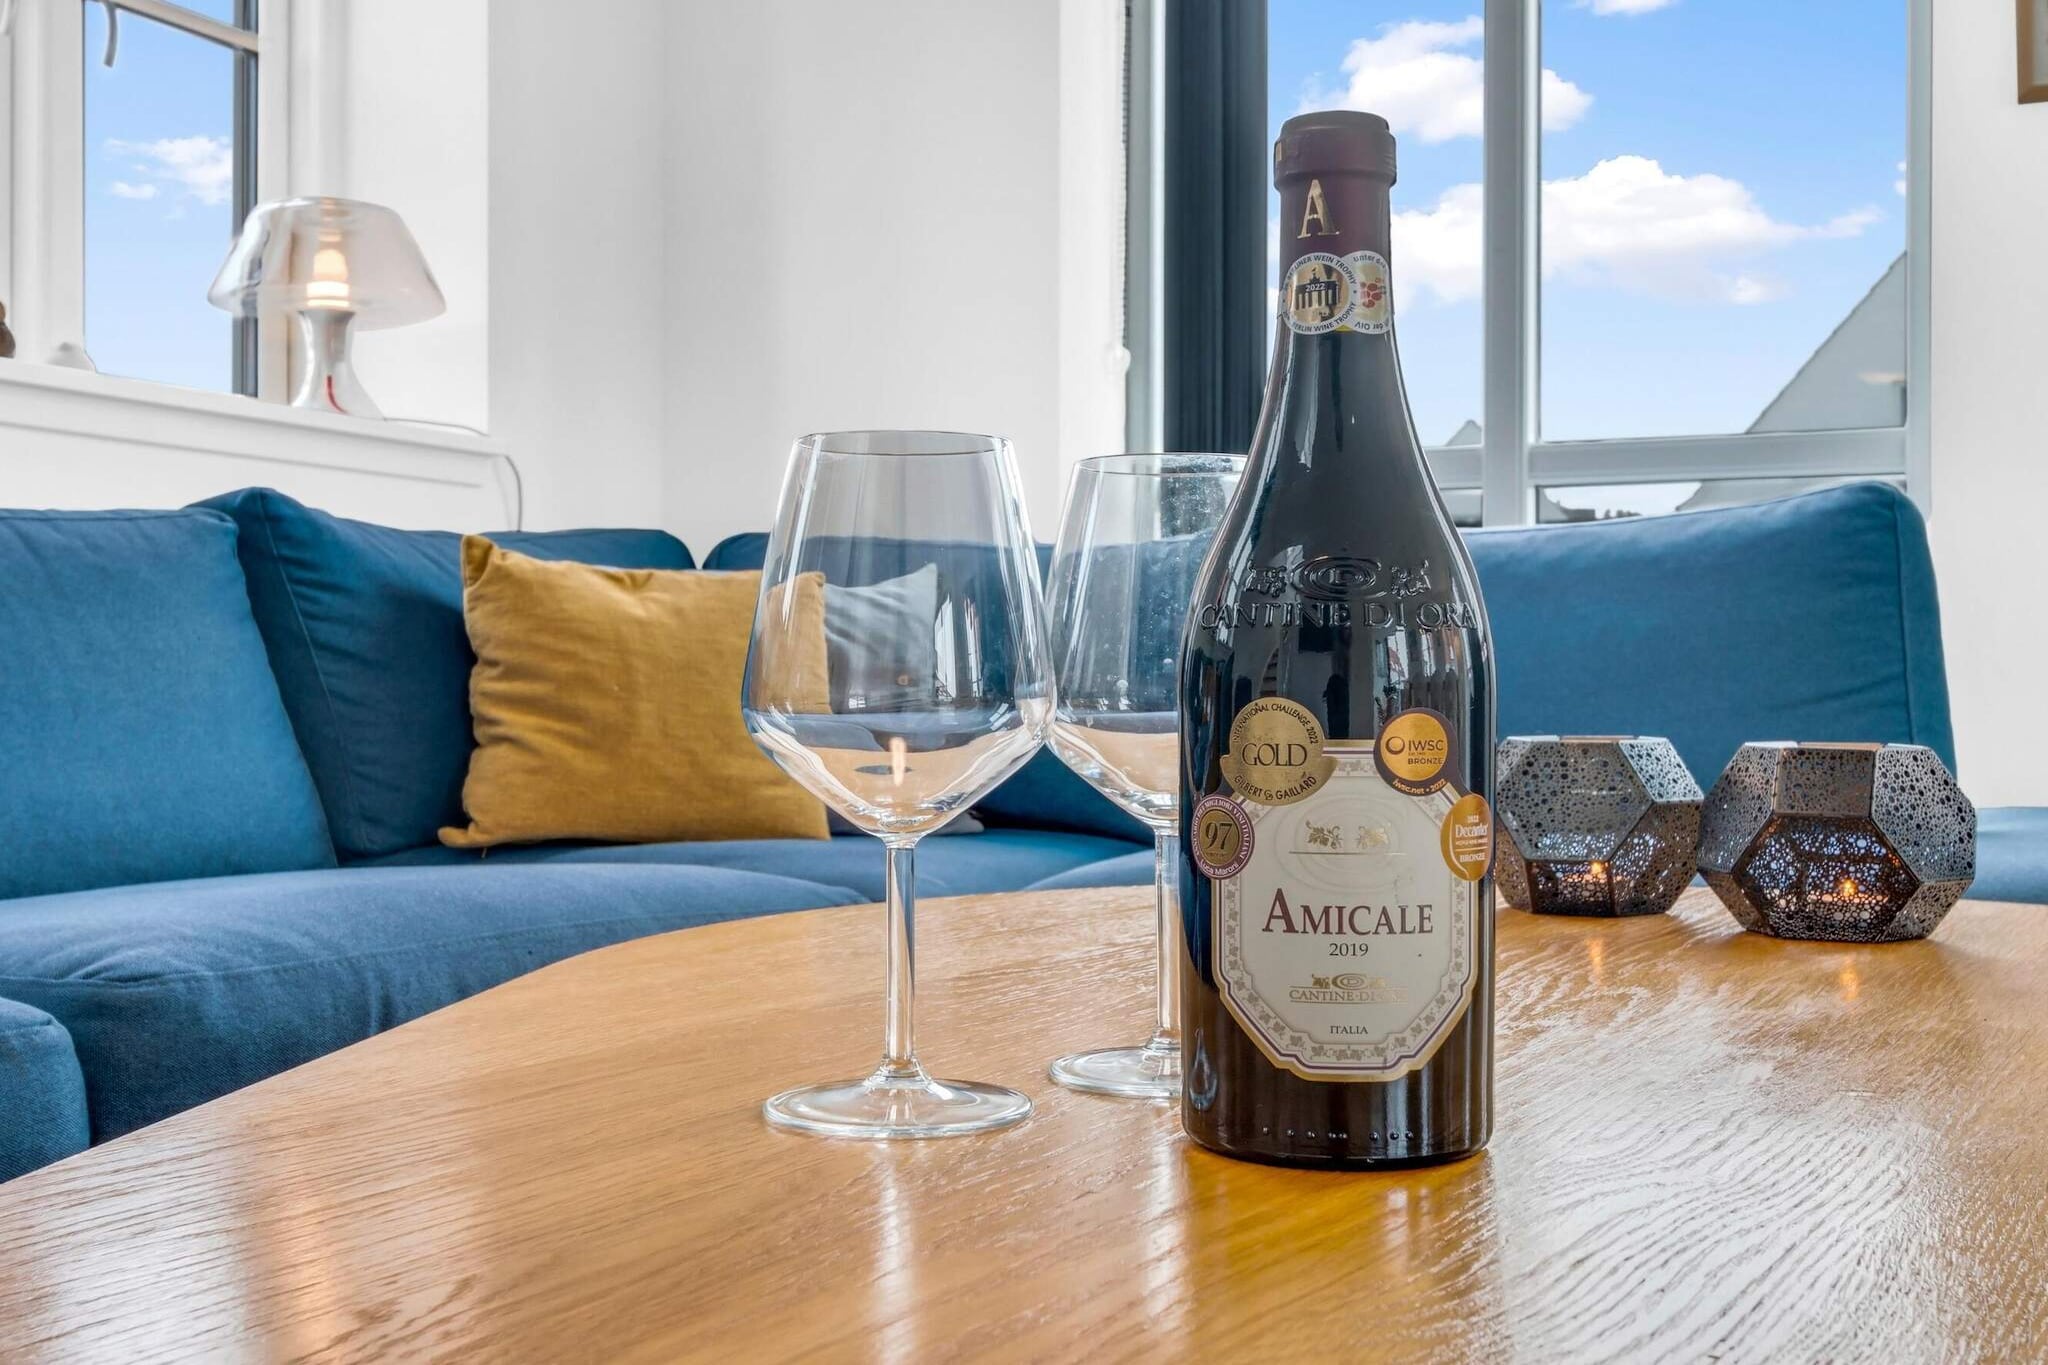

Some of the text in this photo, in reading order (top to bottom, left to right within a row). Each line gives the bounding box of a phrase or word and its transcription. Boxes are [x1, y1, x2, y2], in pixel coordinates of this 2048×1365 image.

[1297, 179, 1340, 239] A
[1313, 255, 1334, 263] WEIN
[1335, 259, 1357, 285] TROPHY
[1305, 283, 1326, 292] 2022
[1313, 321, 1335, 332] WINE
[1335, 302, 1357, 326] TROPHY
[1200, 602, 1479, 629] CANTINE DI ORA
[1233, 703, 1319, 744] INTERNATIONAL CHALLENGE 2022
[1241, 743, 1308, 767] GOLD
[1408, 739, 1444, 751] IWSC
[1408, 757, 1444, 765] BRONZE
[1235, 775, 1262, 797] GILBERT
[1275, 776, 1317, 800] GAILLARD
[1204, 799, 1233, 811] MIGLIORI
[1205, 822, 1233, 850] 97
[1262, 888, 1434, 936] AMICALE
[1329, 942, 1369, 957] 2019
[1330, 1025, 1368, 1035] ITALIA
